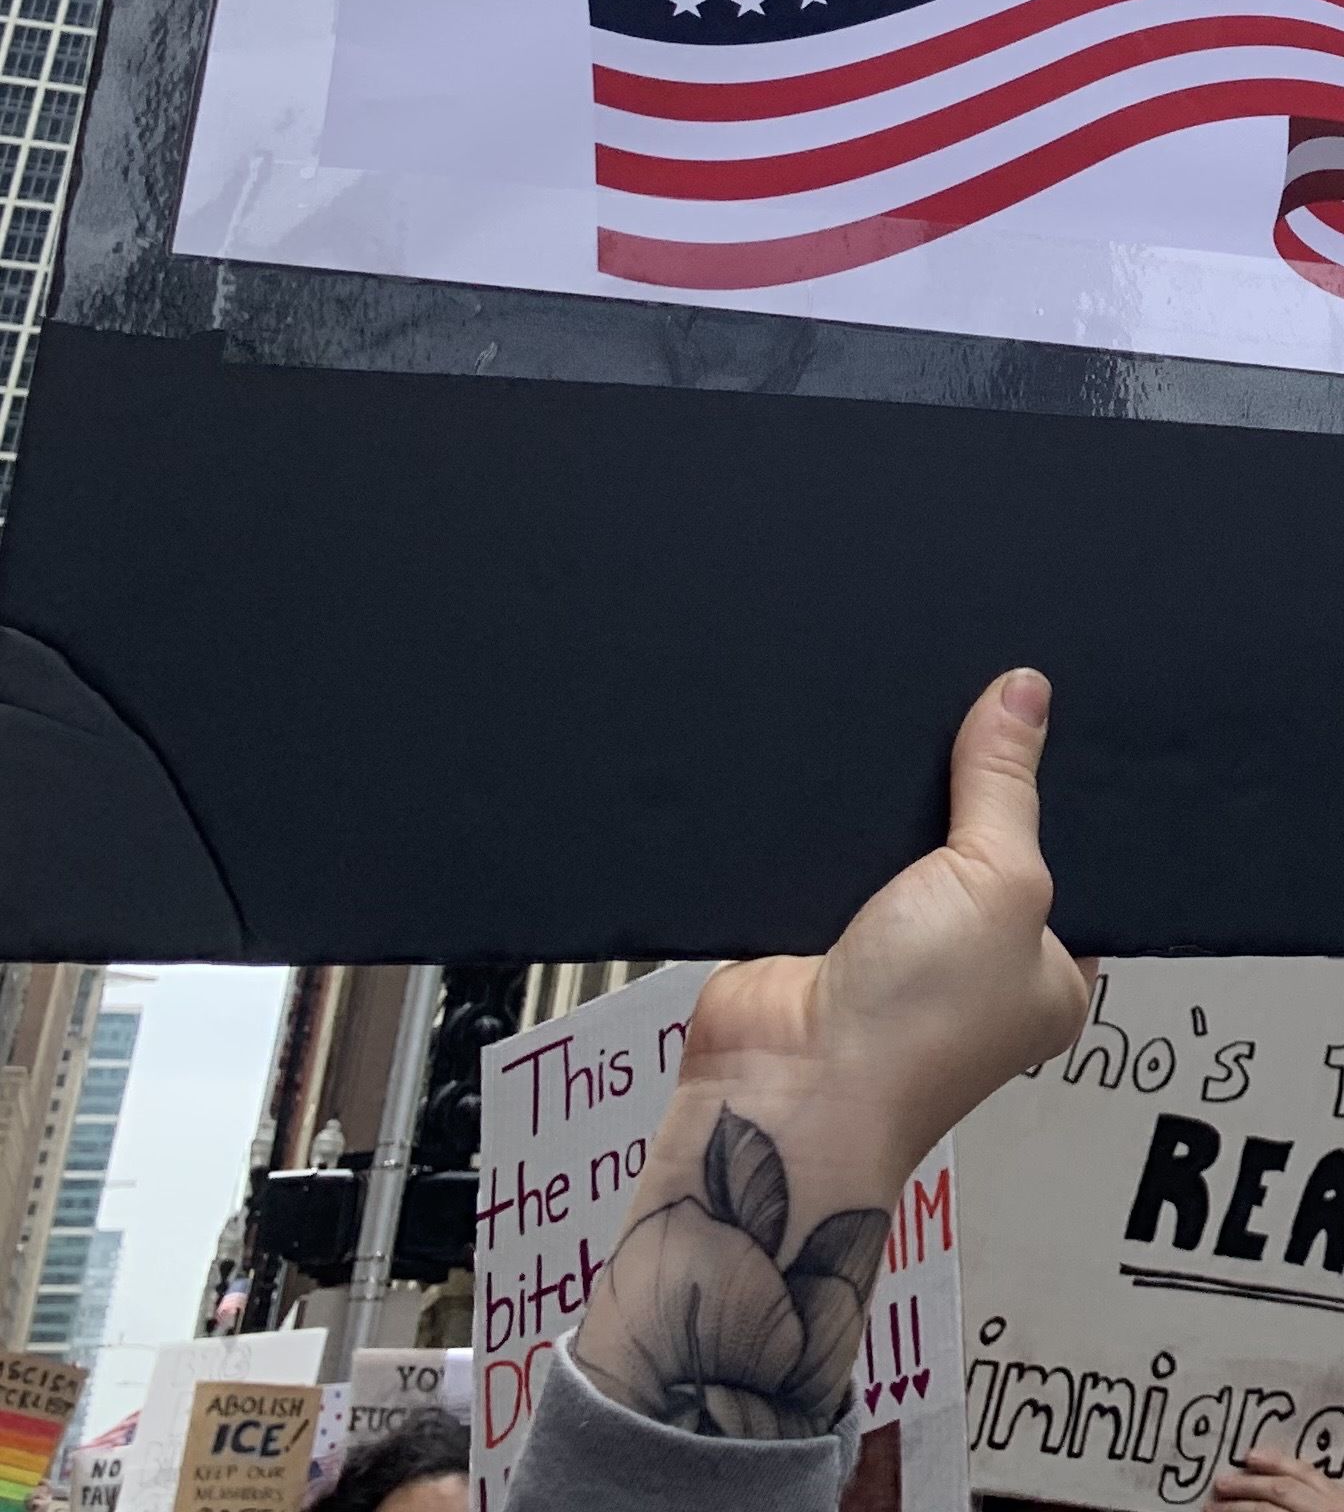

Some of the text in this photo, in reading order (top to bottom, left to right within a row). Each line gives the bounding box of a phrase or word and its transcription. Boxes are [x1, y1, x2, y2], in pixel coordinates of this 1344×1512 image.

[1024, 974, 1255, 1102] ho's
[502, 1036, 633, 1136] This
[476, 1167, 570, 1249] the
[206, 1394, 305, 1417] ABOLISH
[211, 1419, 309, 1458] ICE!
[91, 1458, 122, 1480] NO
